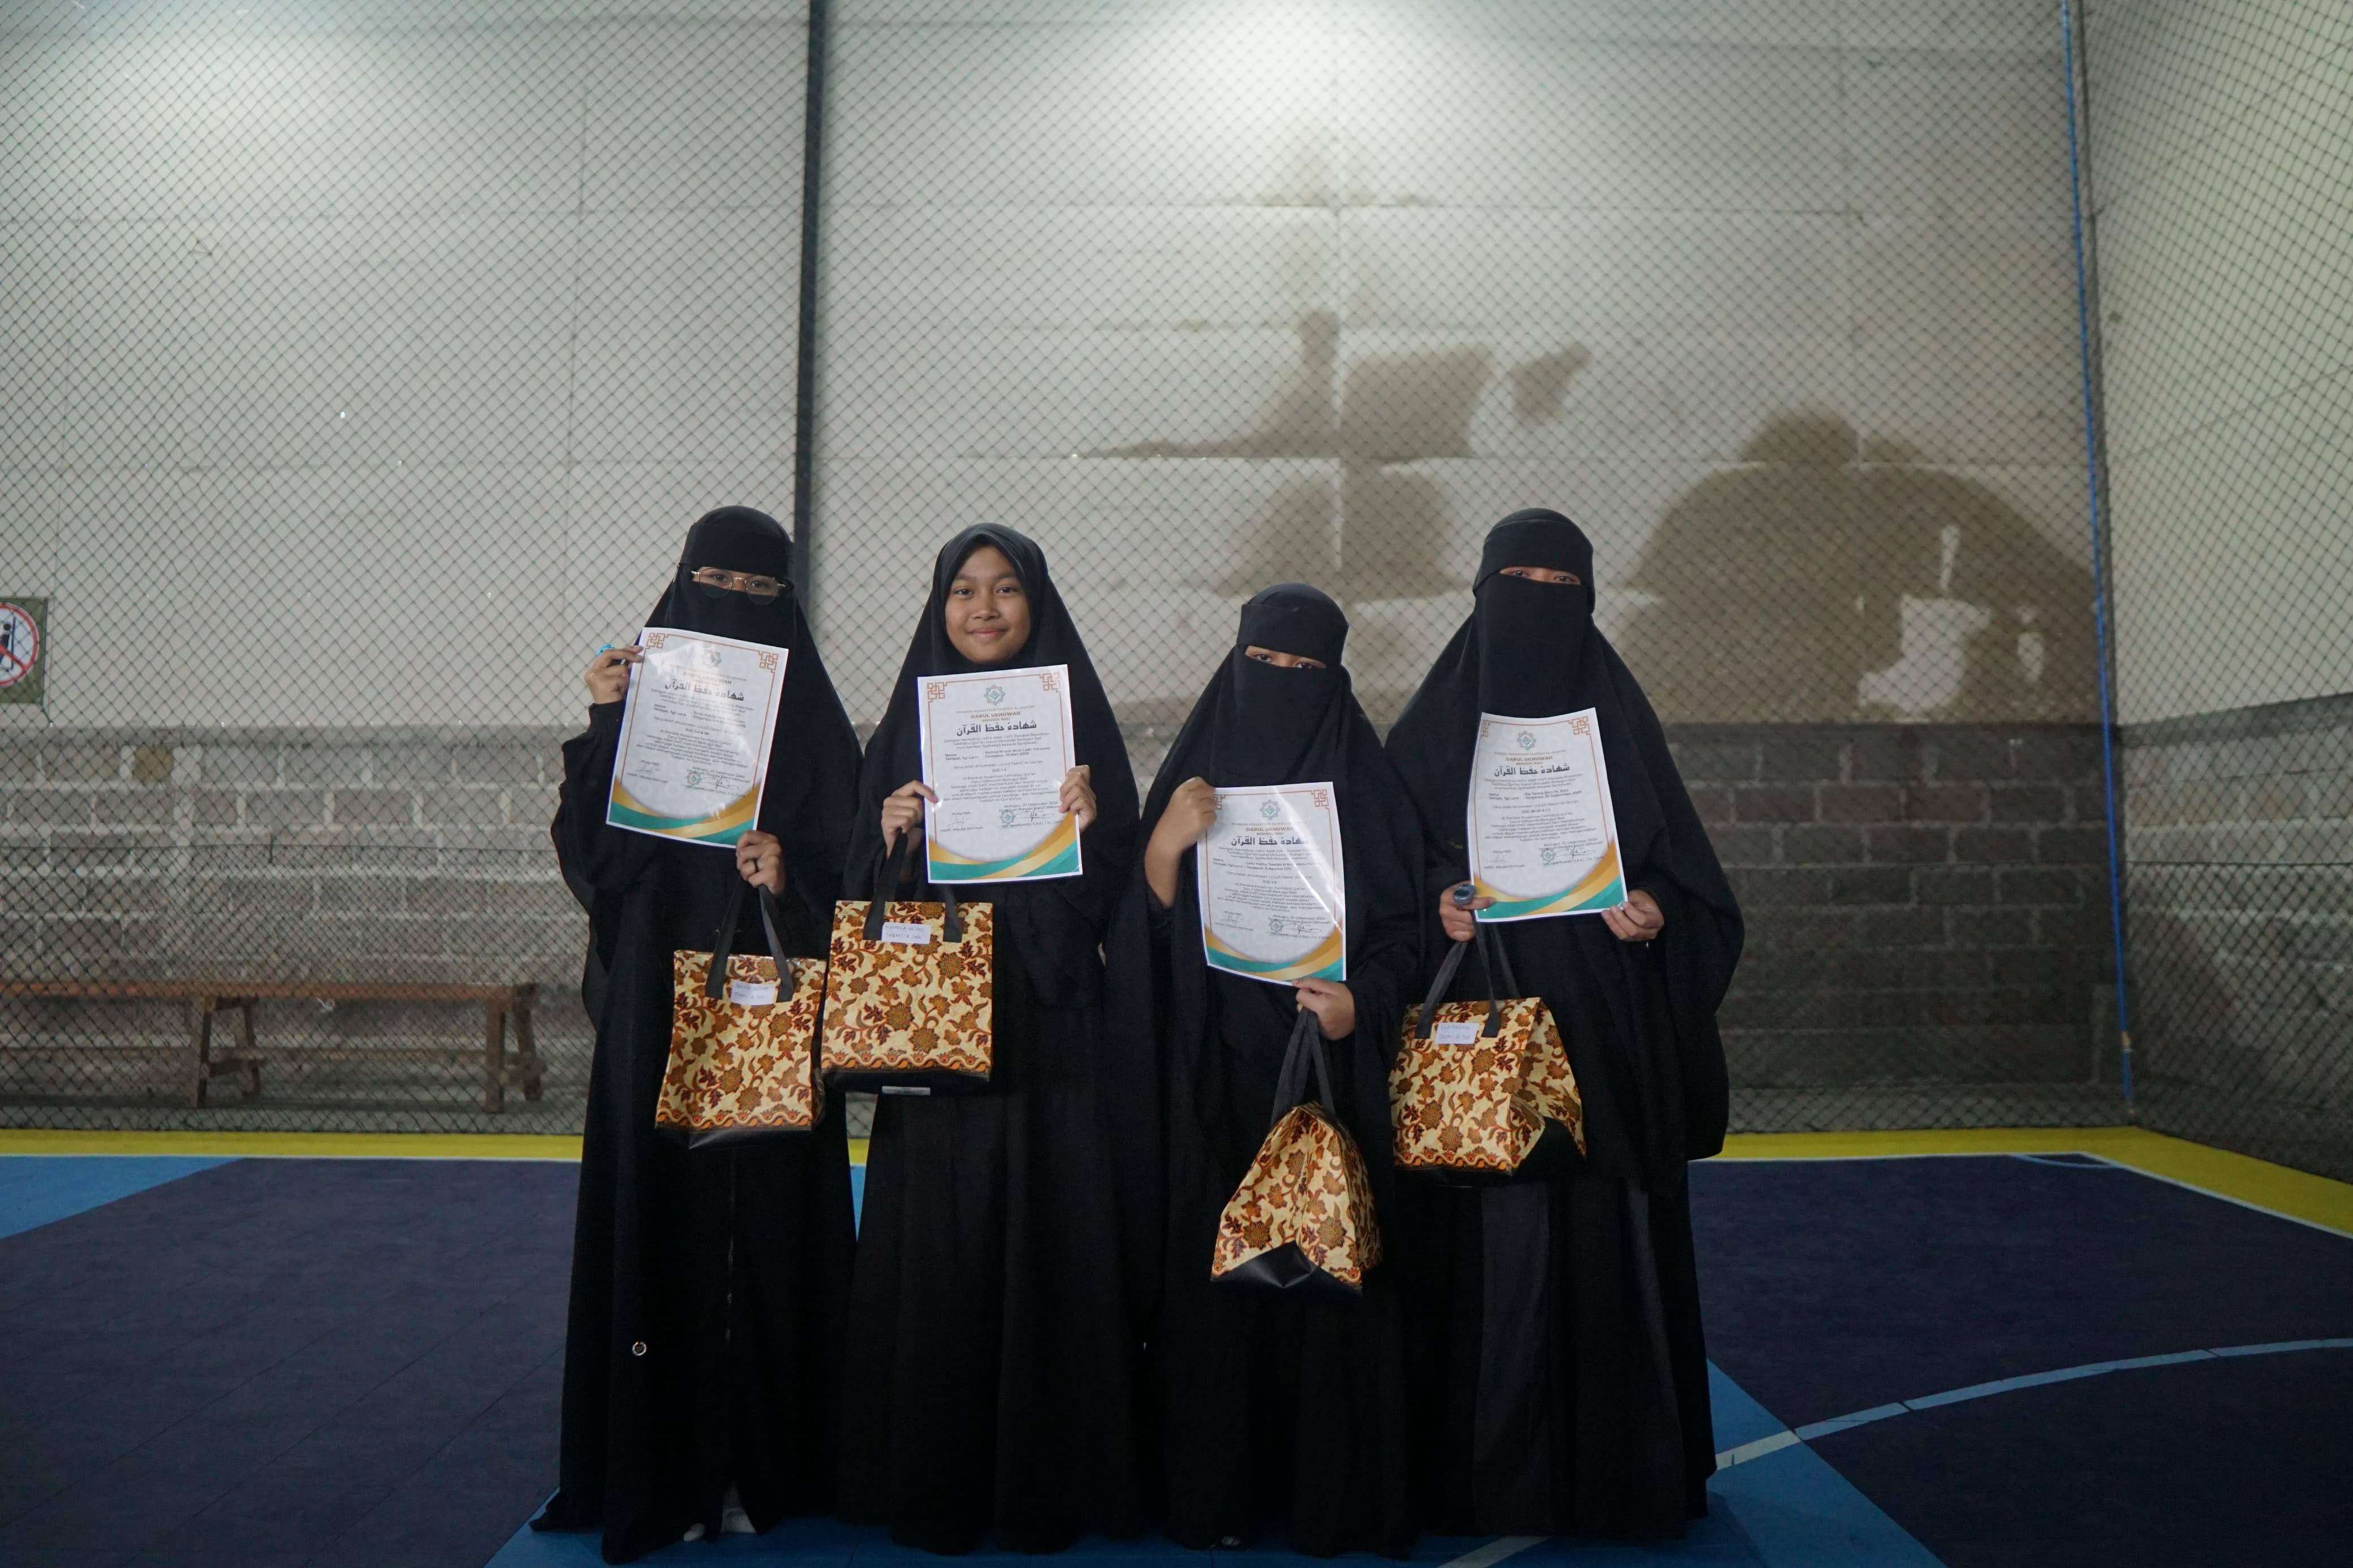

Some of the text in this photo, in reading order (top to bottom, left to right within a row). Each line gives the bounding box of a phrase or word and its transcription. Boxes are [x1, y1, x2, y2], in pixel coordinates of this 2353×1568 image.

[956, 724, 981, 736] القرآن
[985, 722, 1005, 732] حفظ
[1494, 766, 1516, 777] القرآن
[1519, 766, 1538, 775] حفظ
[1231, 836, 1255, 846] القرآن
[1259, 836, 1278, 845] حفظ
